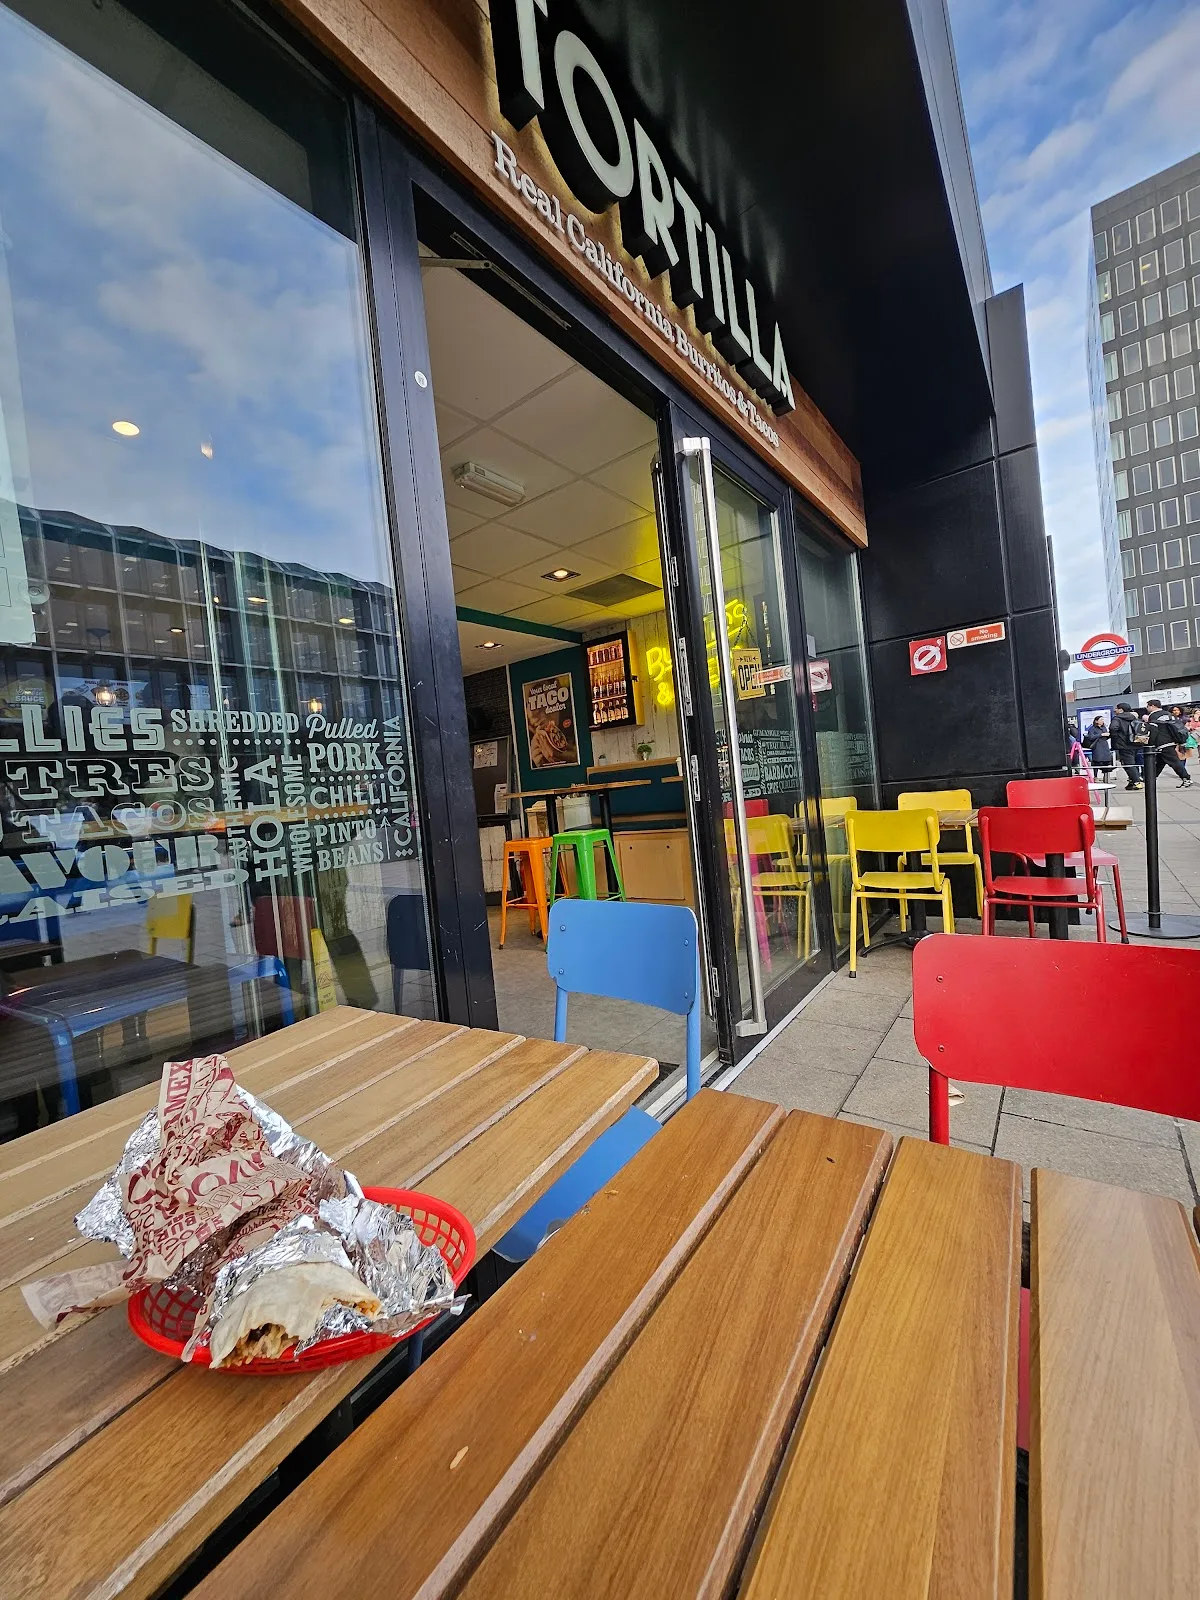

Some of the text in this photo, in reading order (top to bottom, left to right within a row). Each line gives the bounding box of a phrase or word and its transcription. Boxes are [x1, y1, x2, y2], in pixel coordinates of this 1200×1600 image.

[490, 129, 780, 448] Real California Burritos & Tacos
[970, 632, 998, 642] smoking
[1076, 645, 1133, 660] UNDERGROUND
[529, 680, 558, 695] Your local
[738, 663, 763, 691] OPEN
[15, 695, 45, 703] SAUCE
[528, 687, 569, 711] TACO
[544, 703, 567, 715] dealer
[170, 708, 300, 733] SHREDDED
[306, 713, 380, 739] Pulled
[306, 741, 385, 773] PORK
[5, 756, 215, 801] TRES
[383, 715, 413, 847] CALIFORNIA
[764, 763, 799, 782] BARBACOA
[219, 756, 250, 862] AUTHENTIC
[310, 782, 387, 809] CHILLI
[12, 797, 216, 844] TACOS
[244, 754, 289, 882] HOLA
[282, 754, 313, 877] WHOLESOME
[314, 818, 378, 847] PINTO
[317, 841, 385, 873] BEANS
[0, 867, 250, 926] AISED
